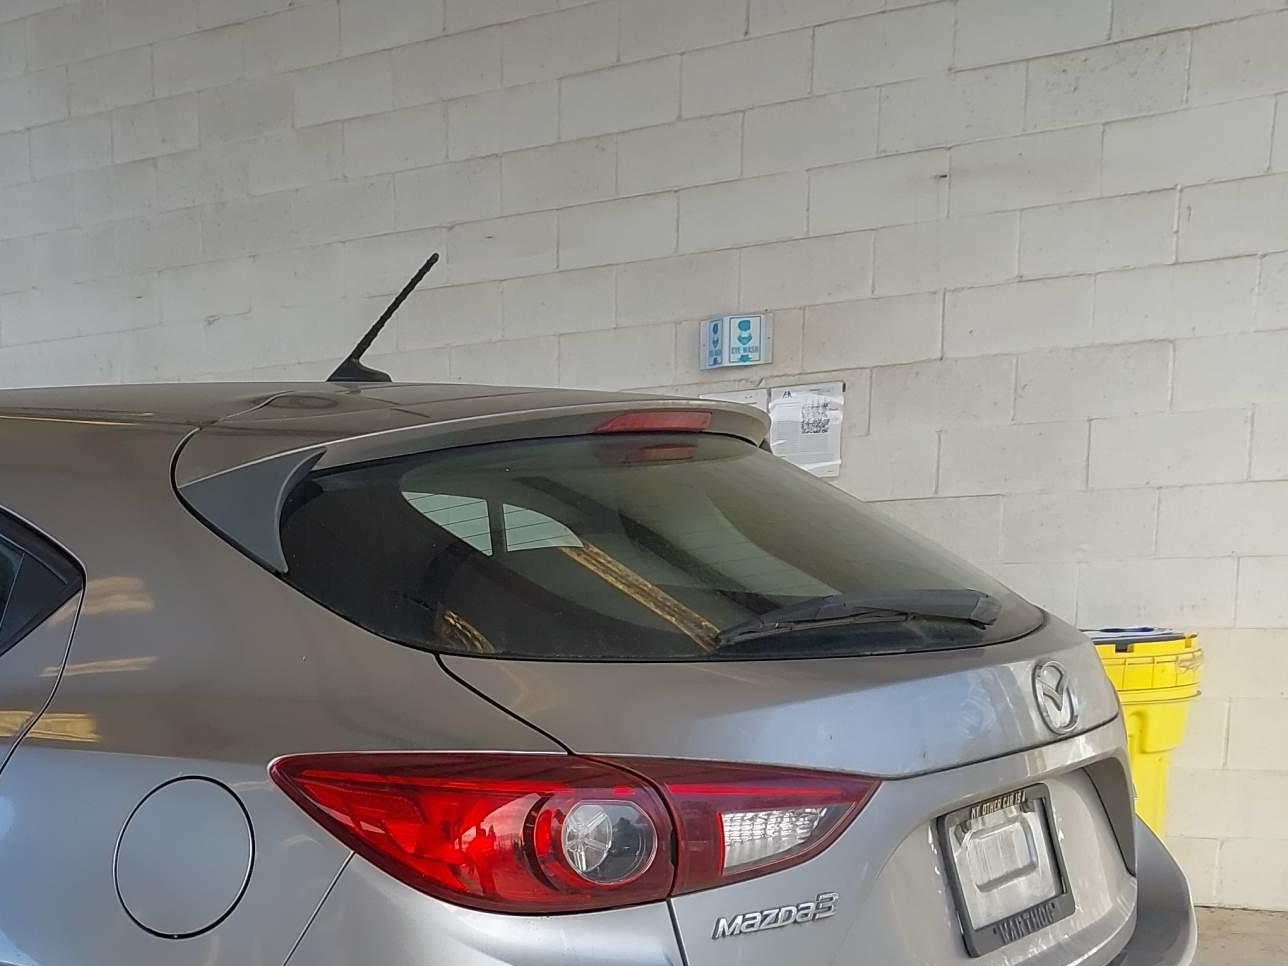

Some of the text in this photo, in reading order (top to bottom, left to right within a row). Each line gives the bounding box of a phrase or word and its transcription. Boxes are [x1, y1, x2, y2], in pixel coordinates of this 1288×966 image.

[982, 799, 1002, 816] OTHER
[1003, 793, 1015, 809] CAR
[999, 904, 1055, 945] WARTHOG
